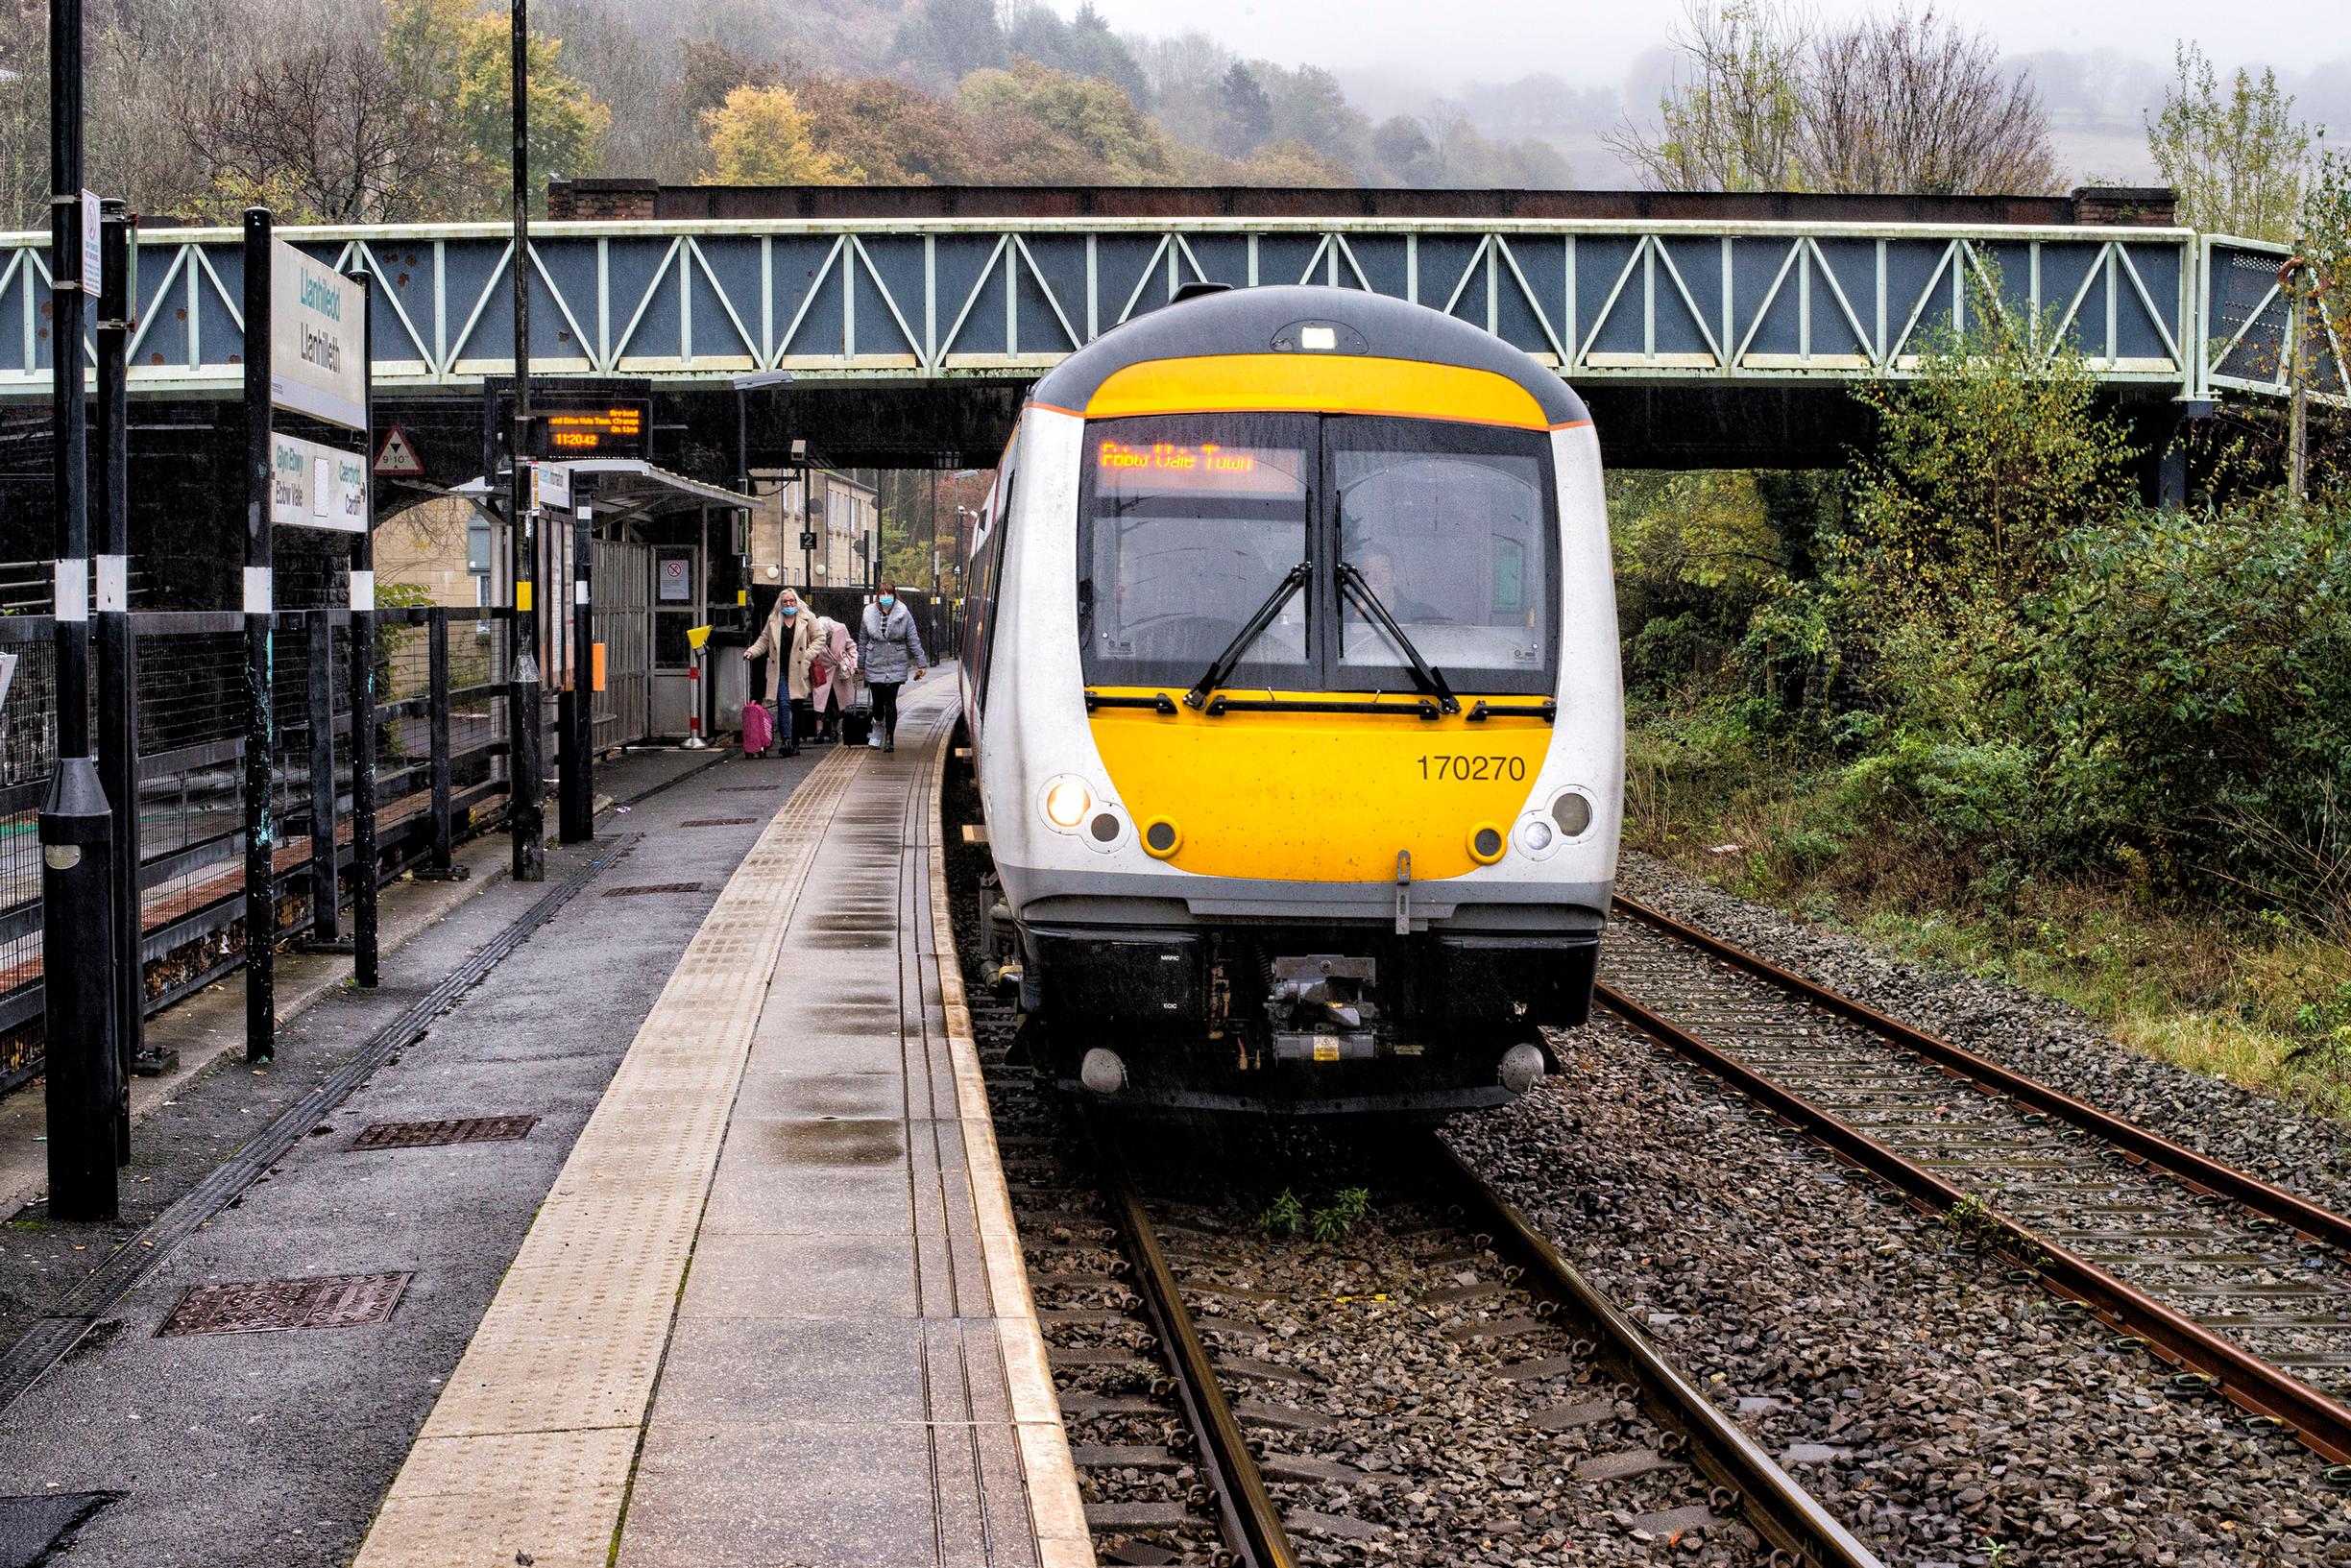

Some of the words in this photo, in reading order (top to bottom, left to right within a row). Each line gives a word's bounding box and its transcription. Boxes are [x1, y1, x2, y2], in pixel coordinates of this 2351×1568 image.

[301, 323, 340, 374] Llanhilleth
[277, 445, 288, 473] Glyn
[290, 447, 303, 477] Ebwy
[277, 480, 291, 505] Ebbw
[292, 482, 303, 507] Vale
[346, 493, 360, 516] Cardiff
[804, 534, 813, 545] 2
[1418, 756, 1525, 781] 170270
